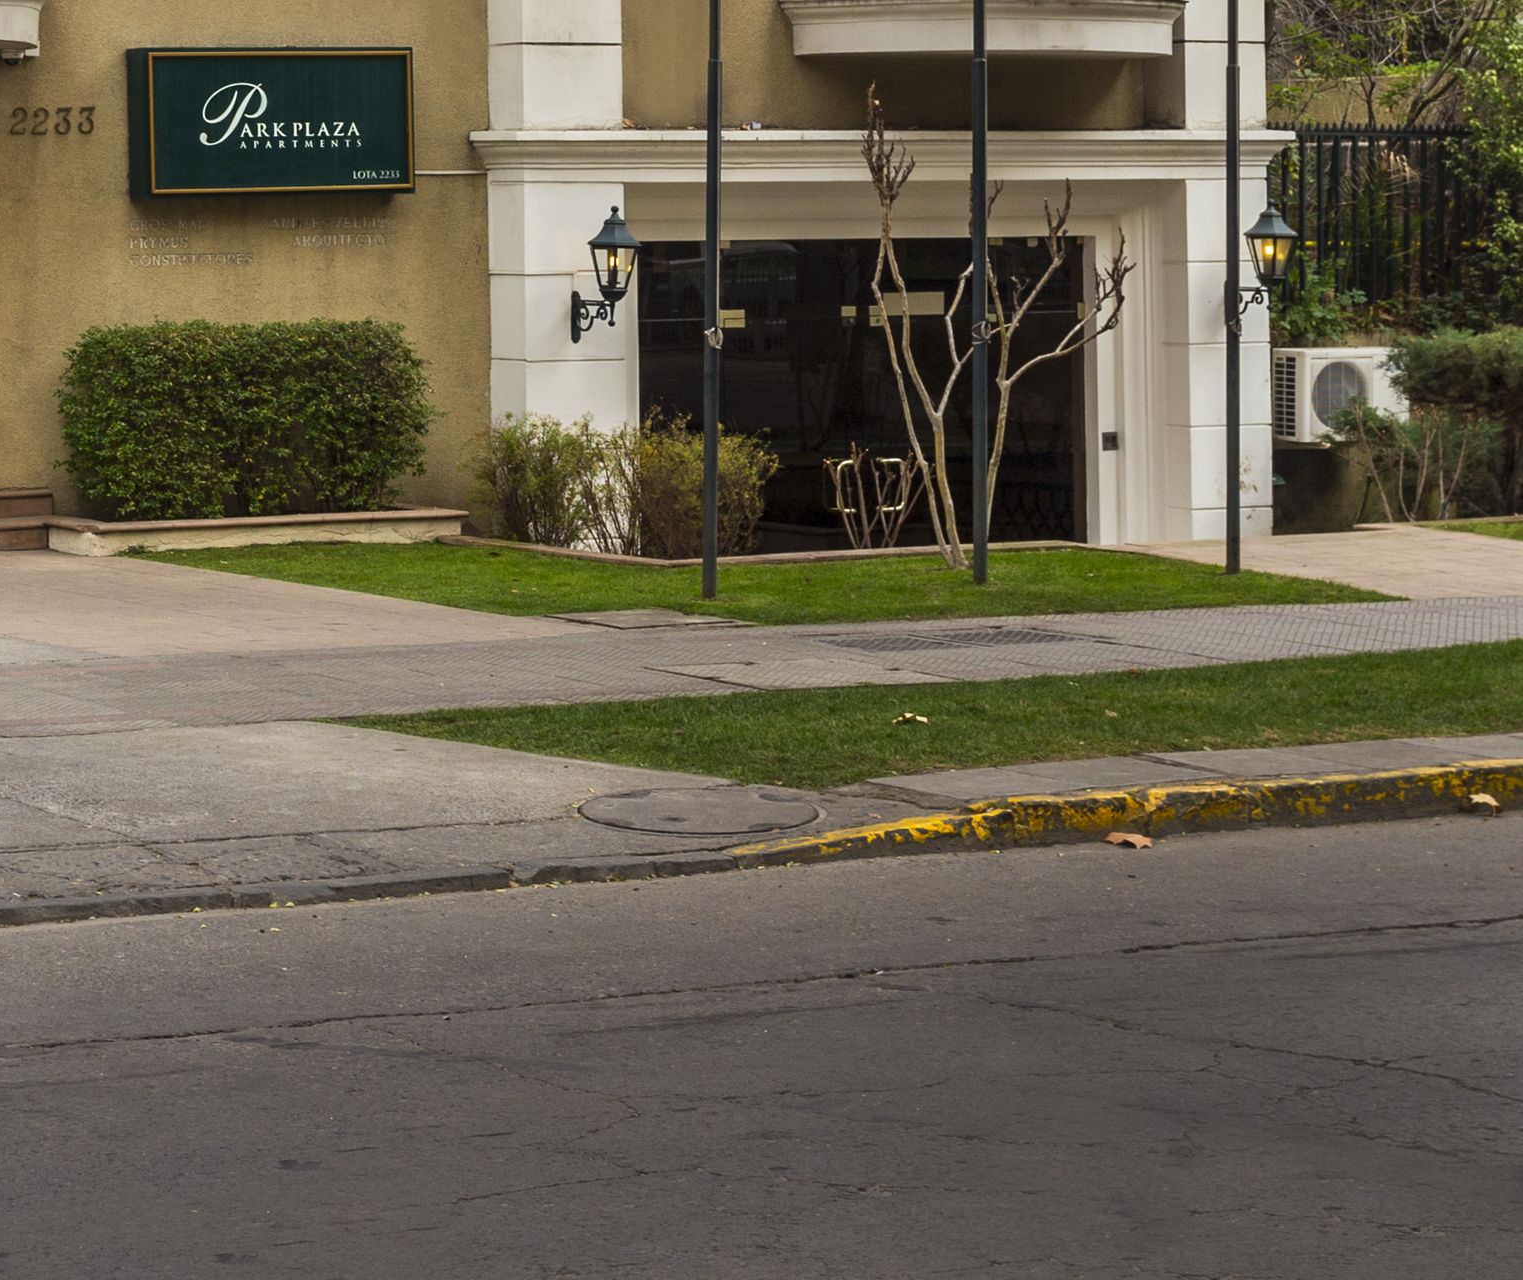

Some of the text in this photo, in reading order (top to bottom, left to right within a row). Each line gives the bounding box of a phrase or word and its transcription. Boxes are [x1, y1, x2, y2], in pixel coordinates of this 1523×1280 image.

[199, 82, 360, 146] PARK PLAZA
[10, 106, 95, 136] 2233
[239, 139, 362, 149] APARTMENTS
[353, 170, 400, 179] LOTA 2233
[129, 237, 188, 249] PRYMUS
